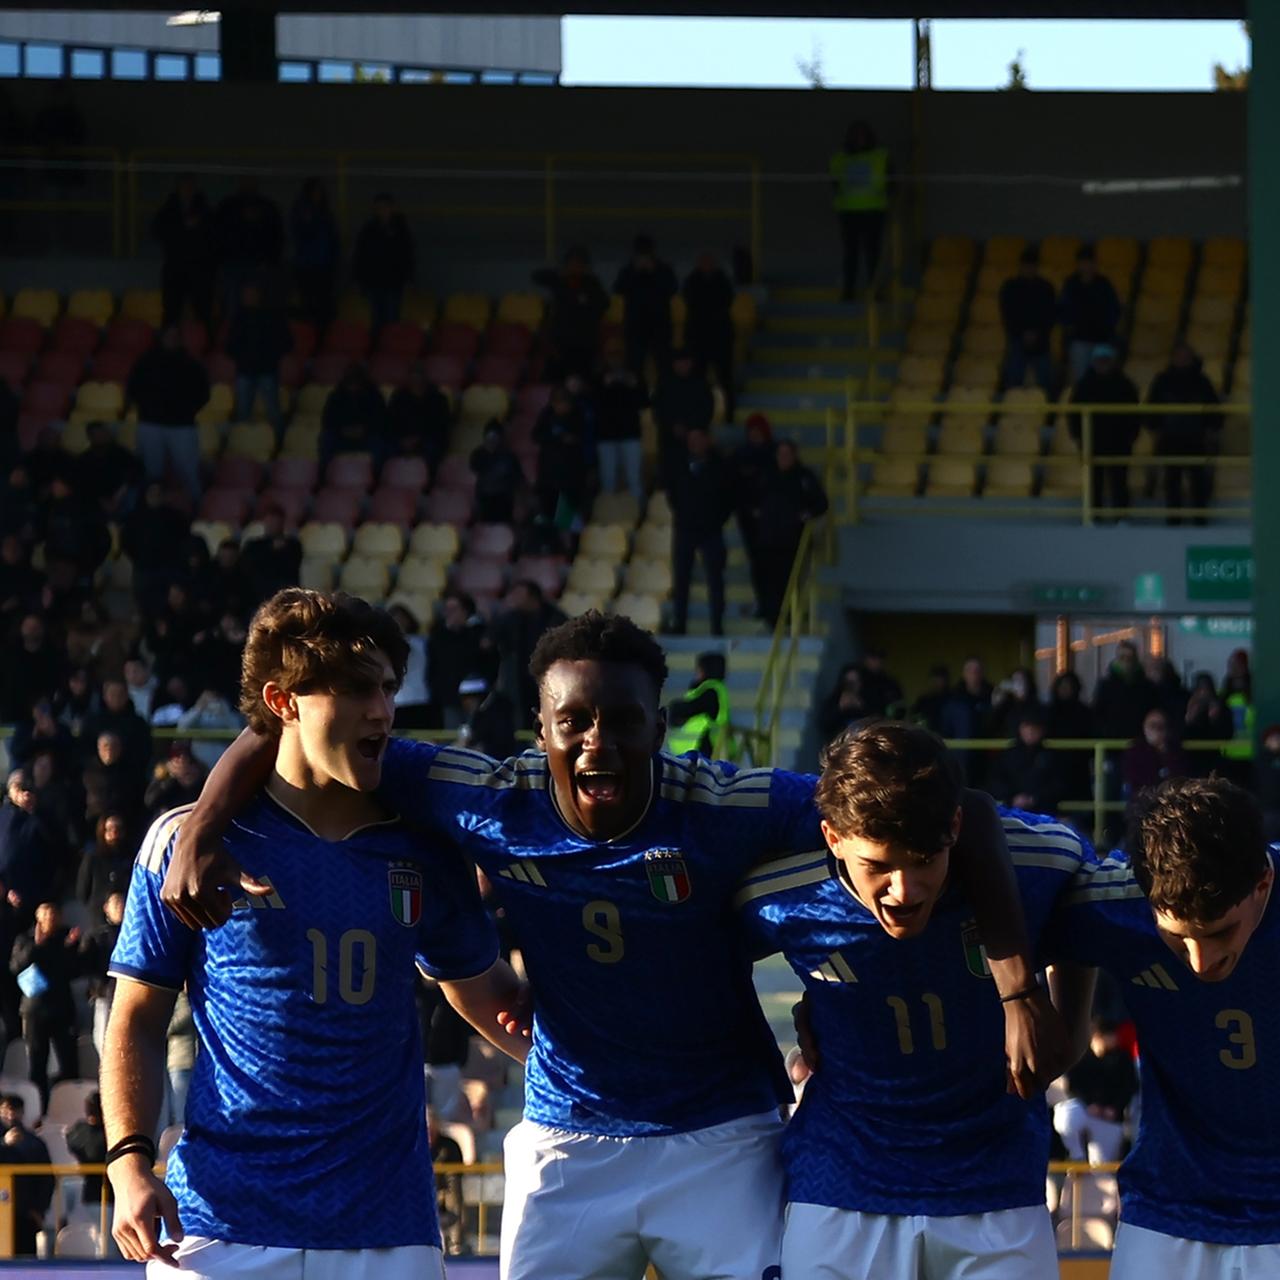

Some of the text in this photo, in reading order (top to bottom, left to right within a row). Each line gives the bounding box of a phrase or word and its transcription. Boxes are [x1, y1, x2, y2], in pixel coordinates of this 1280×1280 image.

[392, 873, 421, 887] ITALIA
[582, 900, 625, 964] 9
[306, 929, 376, 1005] 10
[885, 992, 946, 1055] 11
[1215, 1009, 1256, 1070] 3
